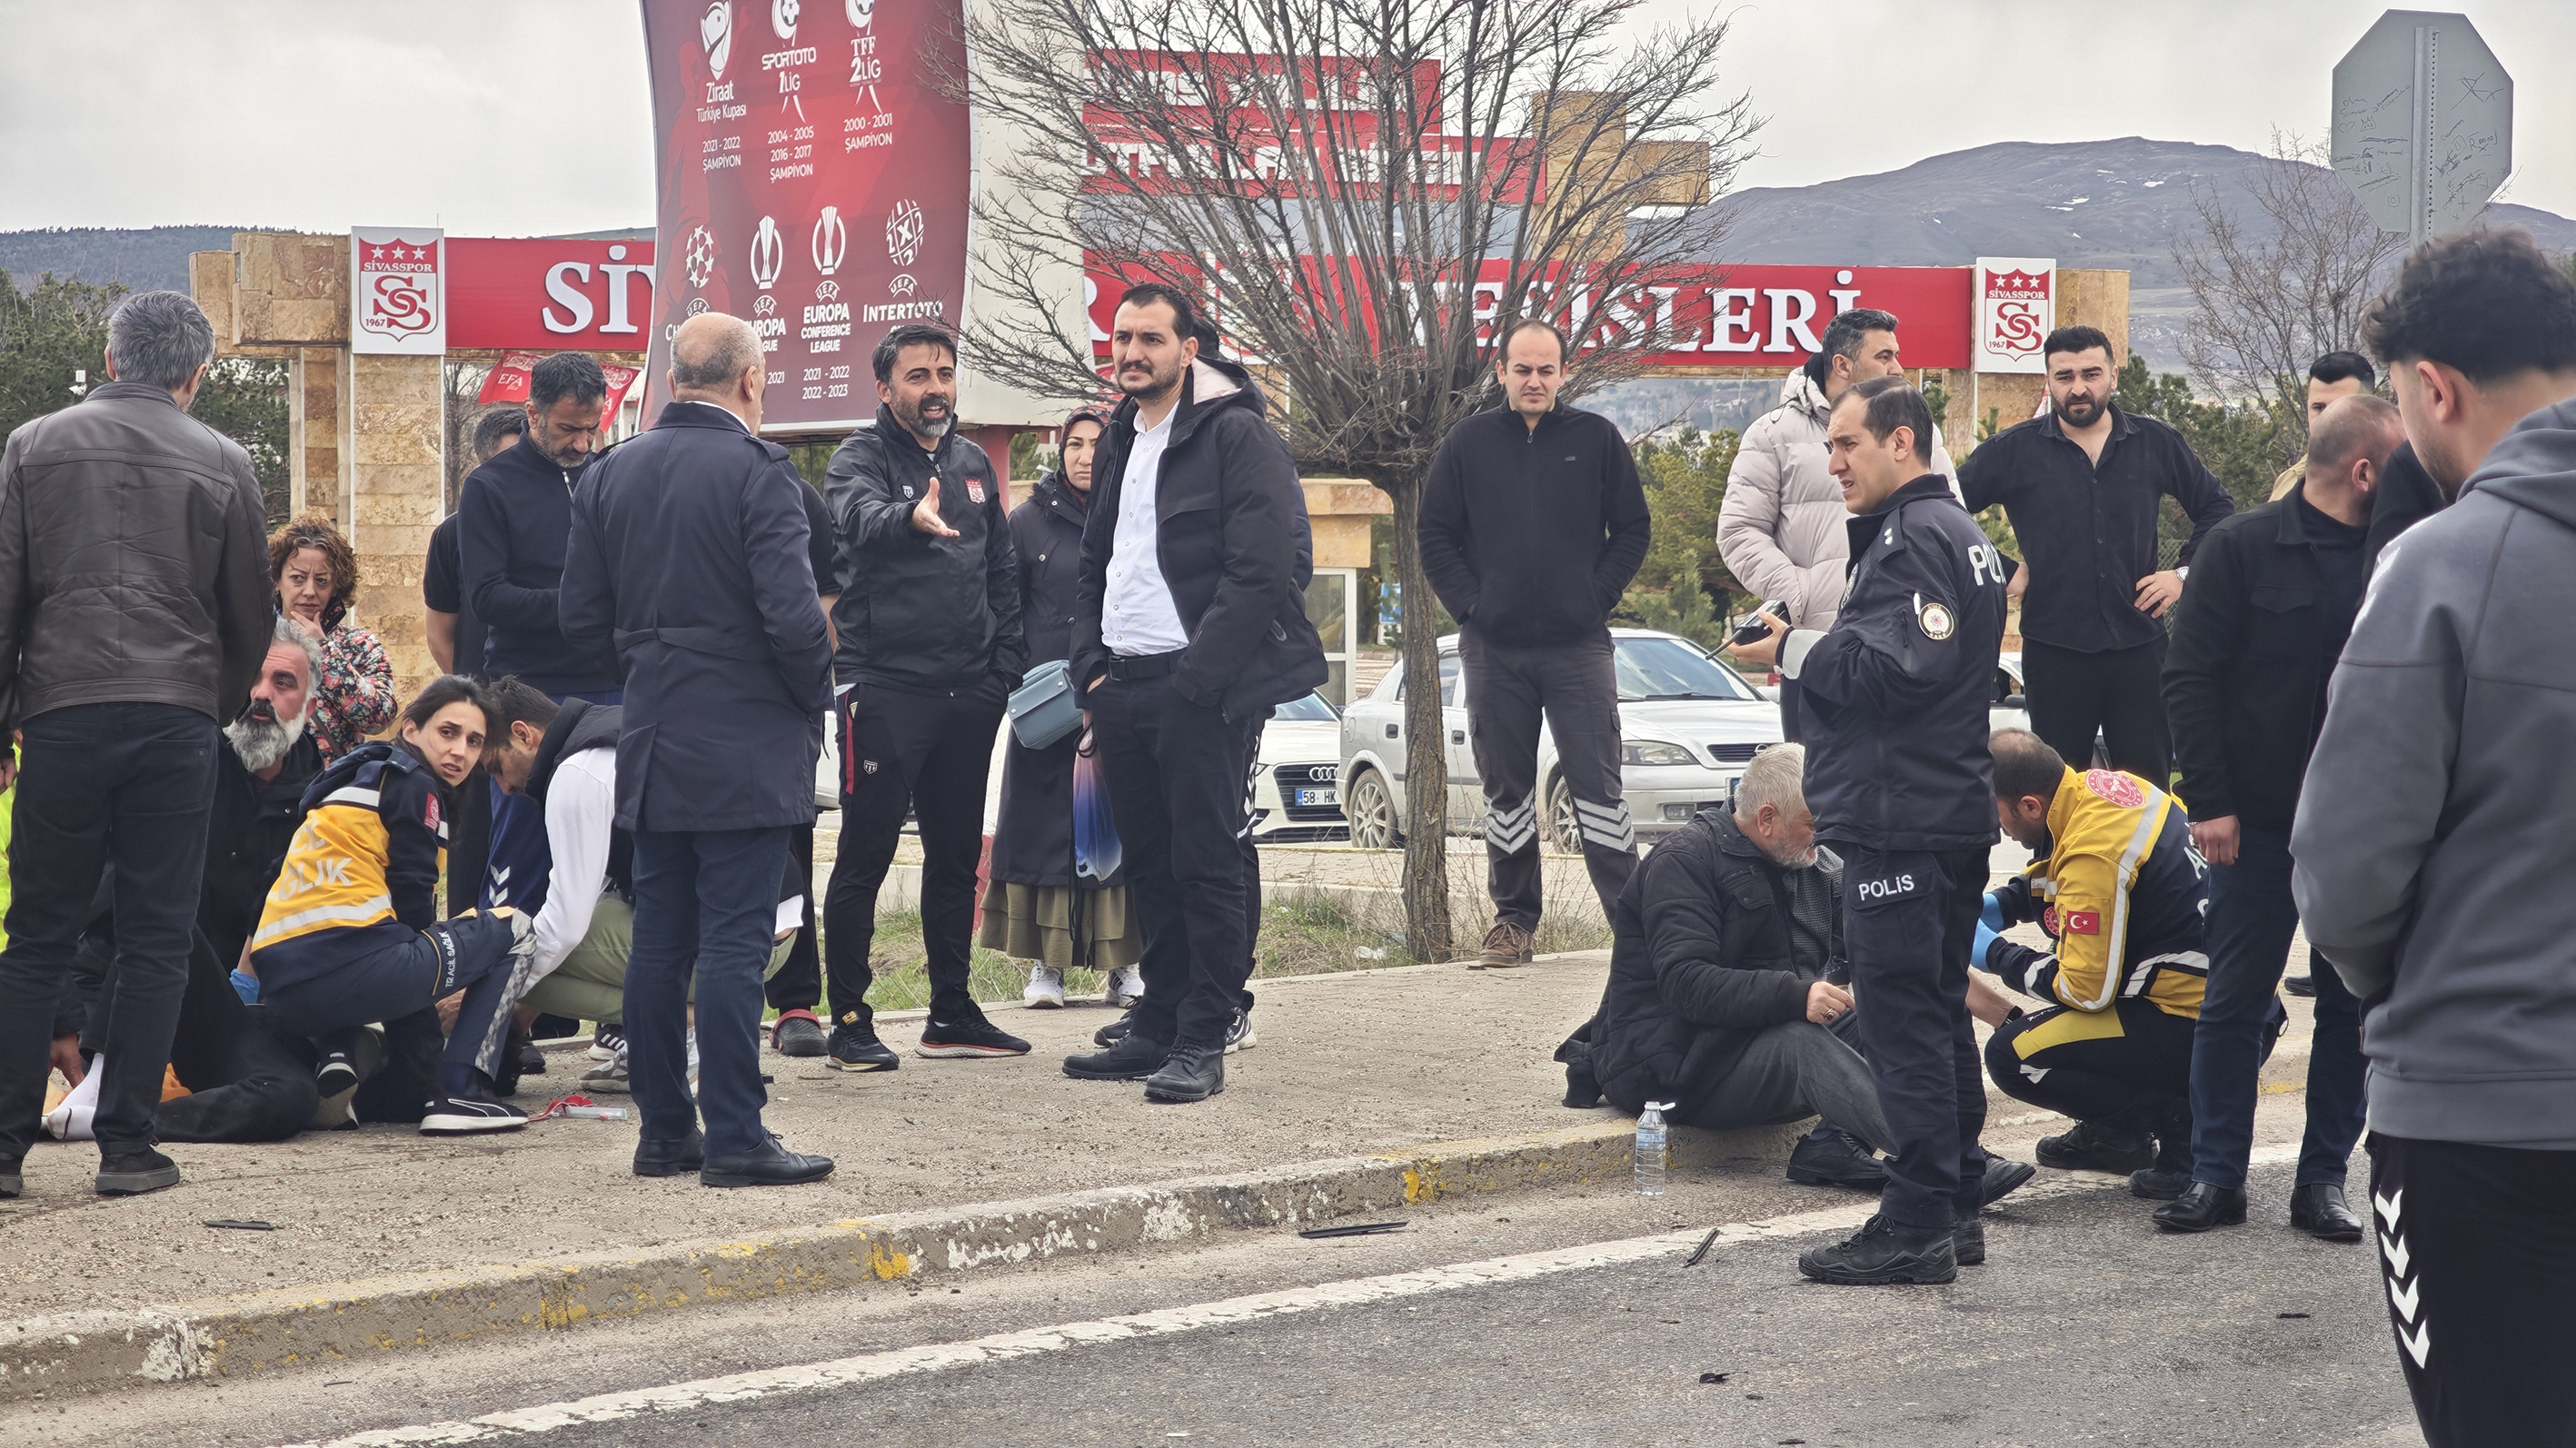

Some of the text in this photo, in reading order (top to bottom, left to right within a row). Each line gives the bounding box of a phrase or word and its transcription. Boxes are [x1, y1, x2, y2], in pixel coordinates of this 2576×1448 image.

[850, 35, 876, 56] TFF
[705, 79, 734, 104] Ziraat
[696, 104, 747, 124] Türkiye Kupası
[843, 116, 866, 132] 2000
[872, 113, 892, 128] 2001
[767, 129, 788, 144] 2004
[793, 125, 814, 141] 2005
[845, 132, 892, 154] ŞAMPİYON
[702, 139, 718, 153] 2021
[723, 136, 741, 151] 2022
[770, 147, 789, 162] 2016
[793, 144, 812, 159] 2017
[702, 154, 741, 174] ŞAMPİYON
[770, 163, 813, 183] ŞAMPİYON
[363, 259, 433, 273] SİVASSPOR
[816, 283, 838, 299] UEFA
[890, 278, 915, 294] UEFA
[1988, 287, 2045, 300] SİVASSPOR
[686, 301, 708, 317] UEFA
[754, 298, 775, 314] UEFA
[803, 302, 850, 324] EUROPA
[862, 300, 943, 322] INTERTOTO
[365, 318, 386, 327] 1967
[801, 323, 851, 340] CONFERENCE
[810, 339, 840, 354] LEAGUE
[1988, 341, 2005, 349] 1967
[767, 371, 785, 385] 2021
[803, 367, 821, 382] 2021
[829, 364, 850, 379] 2022
[801, 385, 822, 400] 2022
[828, 383, 849, 398] 2023
[1303, 791, 1316, 804] 58
[1324, 790, 1337, 804] HK
